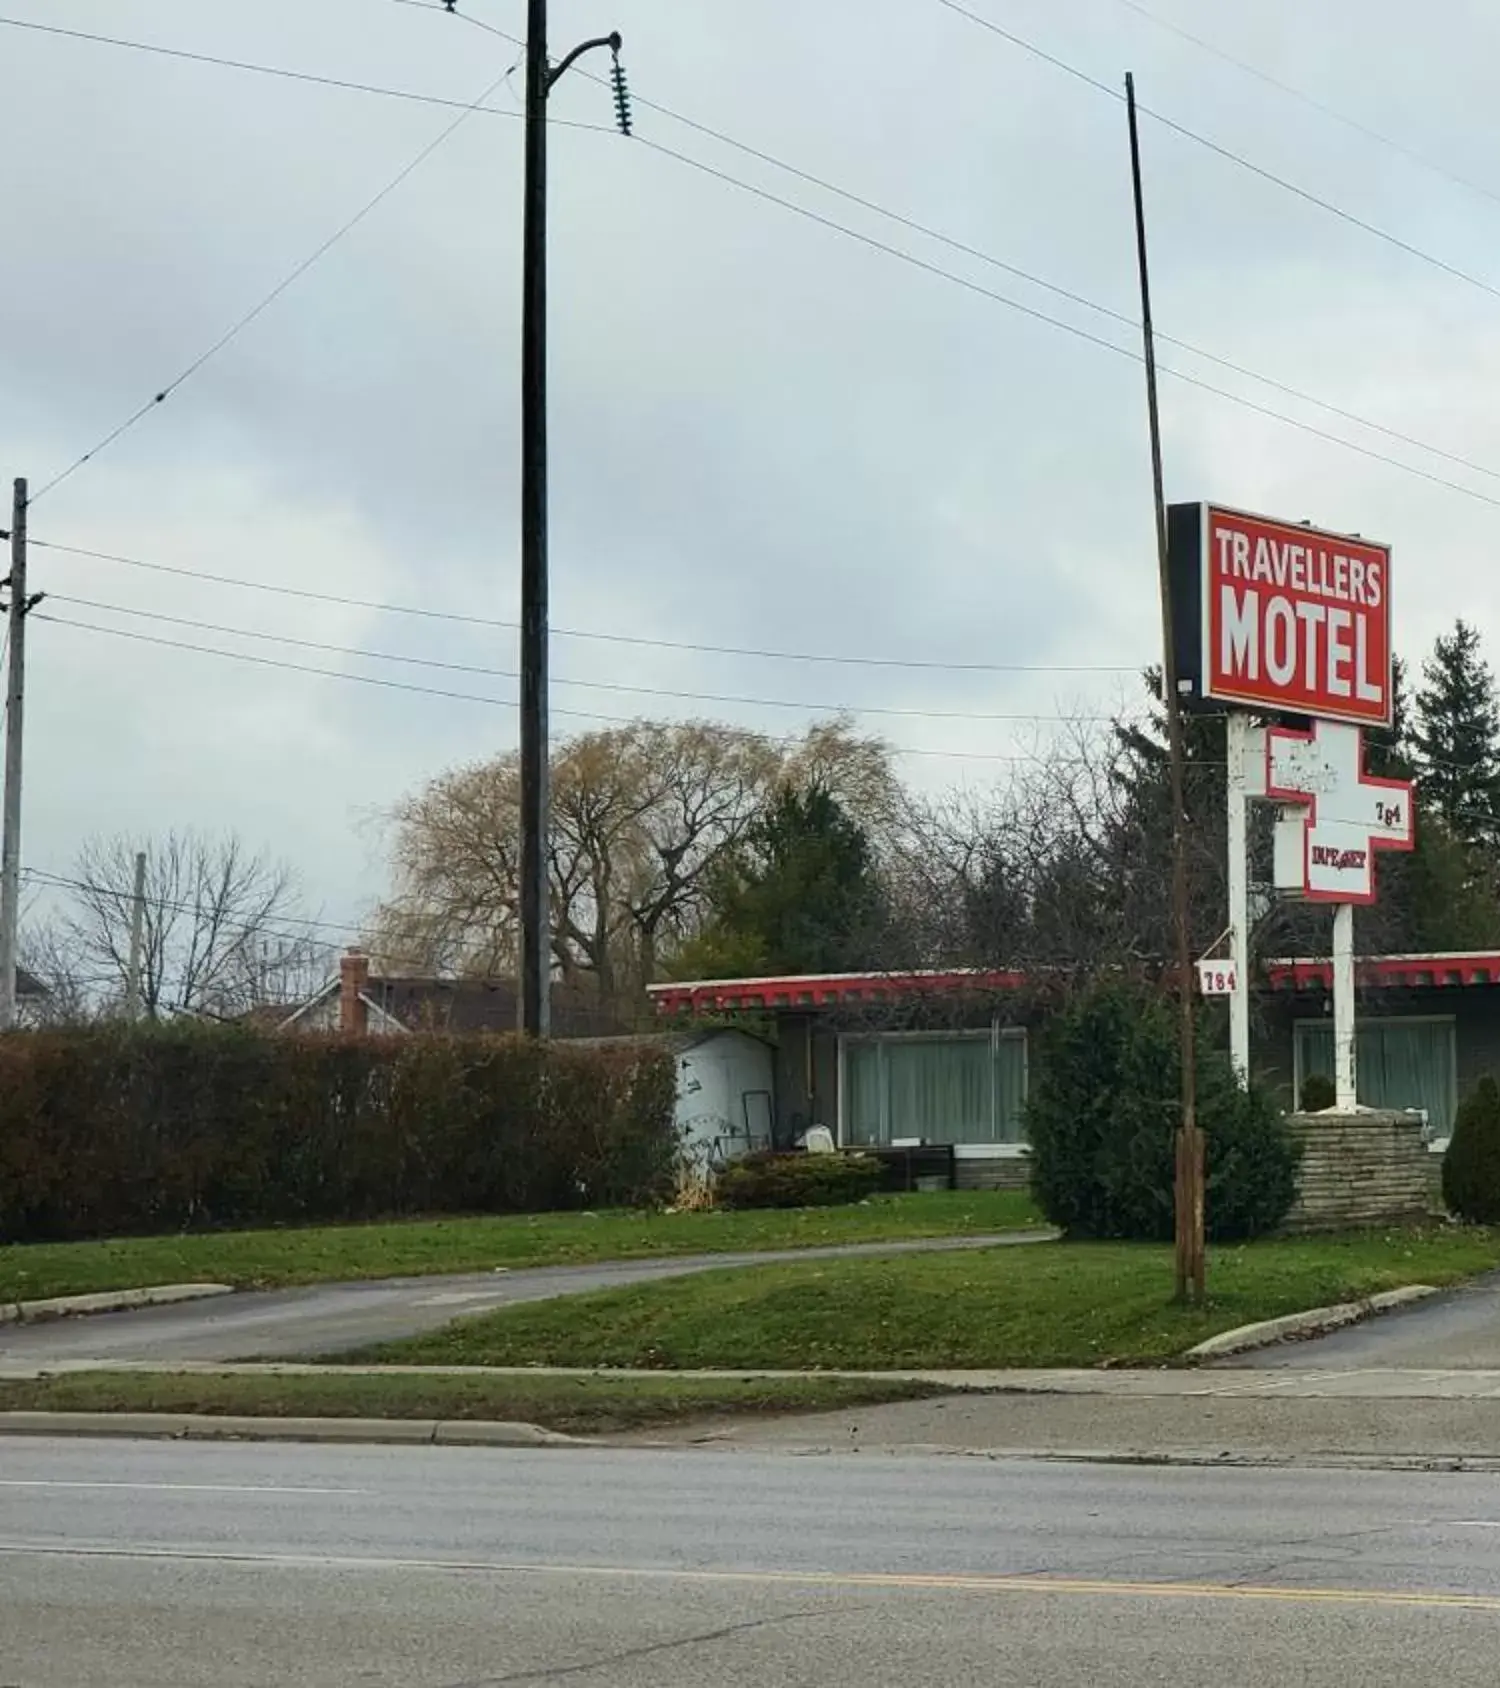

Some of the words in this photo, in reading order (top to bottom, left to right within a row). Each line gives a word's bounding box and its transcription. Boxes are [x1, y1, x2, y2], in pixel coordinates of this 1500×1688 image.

[1215, 527, 1381, 607] TRAVELLERS
[1220, 585, 1383, 703] MOTEL
[1375, 801, 1401, 827] 784
[1203, 971, 1236, 991] 784
